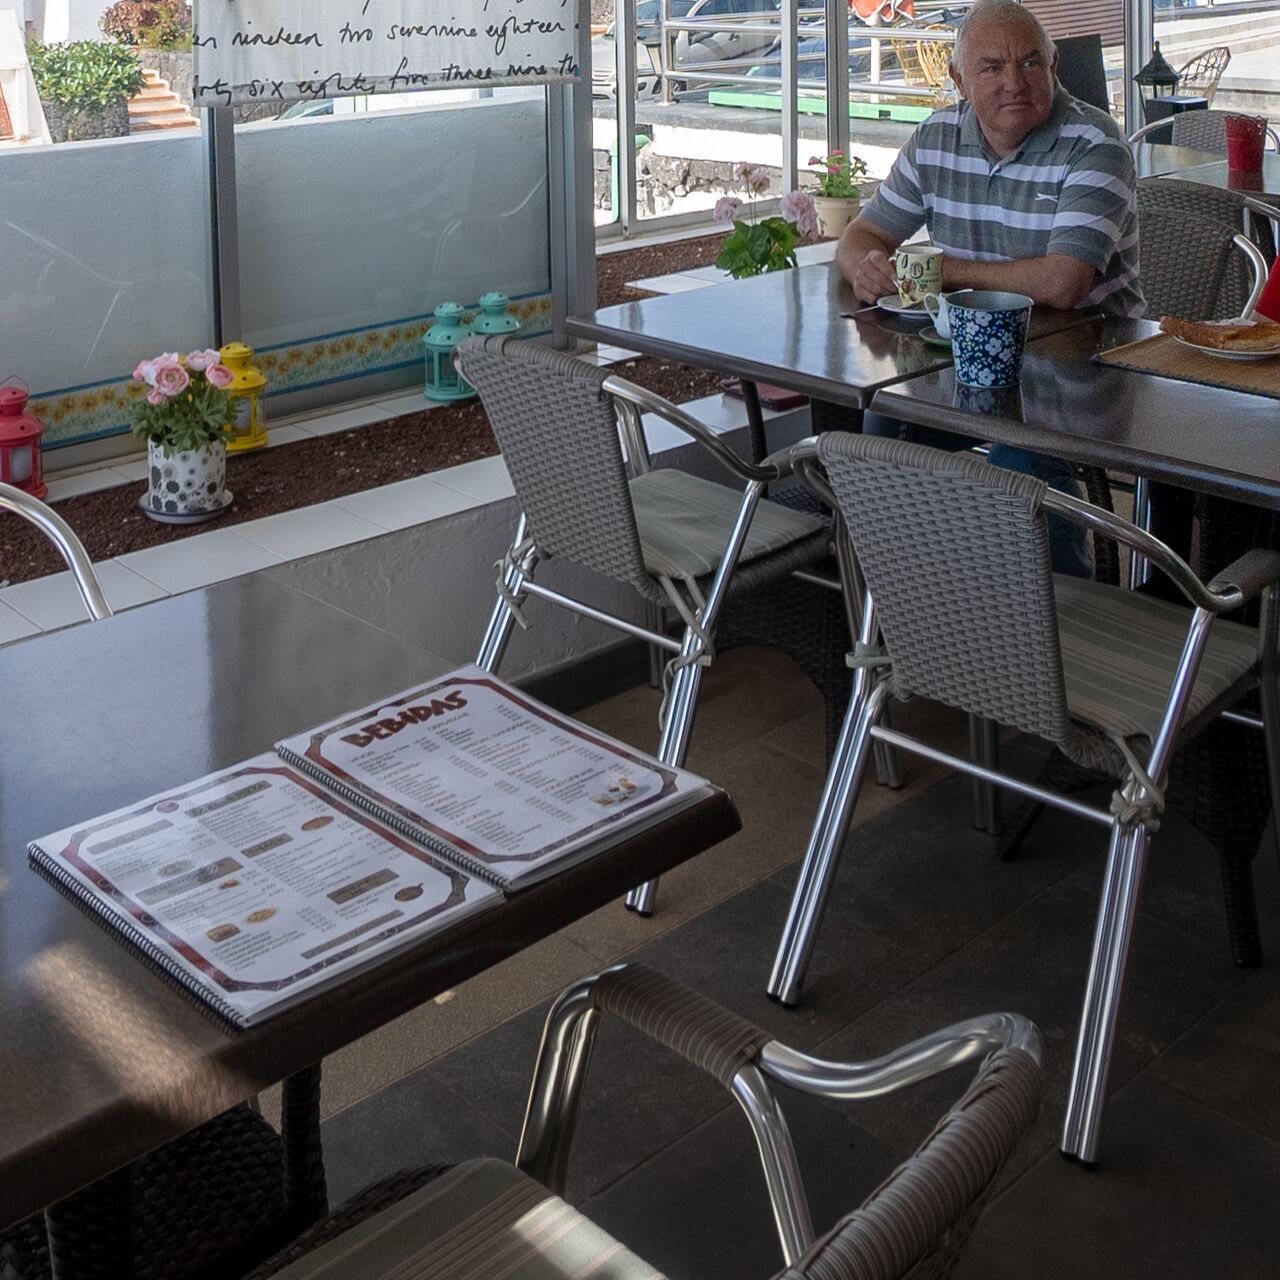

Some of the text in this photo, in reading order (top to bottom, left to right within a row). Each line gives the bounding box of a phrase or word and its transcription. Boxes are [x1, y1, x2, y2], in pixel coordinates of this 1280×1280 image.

[232, 21, 323, 47] nineteen
[339, 22, 373, 44] two
[485, 10, 565, 56] eighteen
[247, 78, 284, 99] six
[297, 70, 377, 101] eighty
[388, 56, 429, 89] five
[443, 63, 494, 81] three
[507, 54, 547, 78] nine
[340, 690, 468, 748] BEBIDAS
